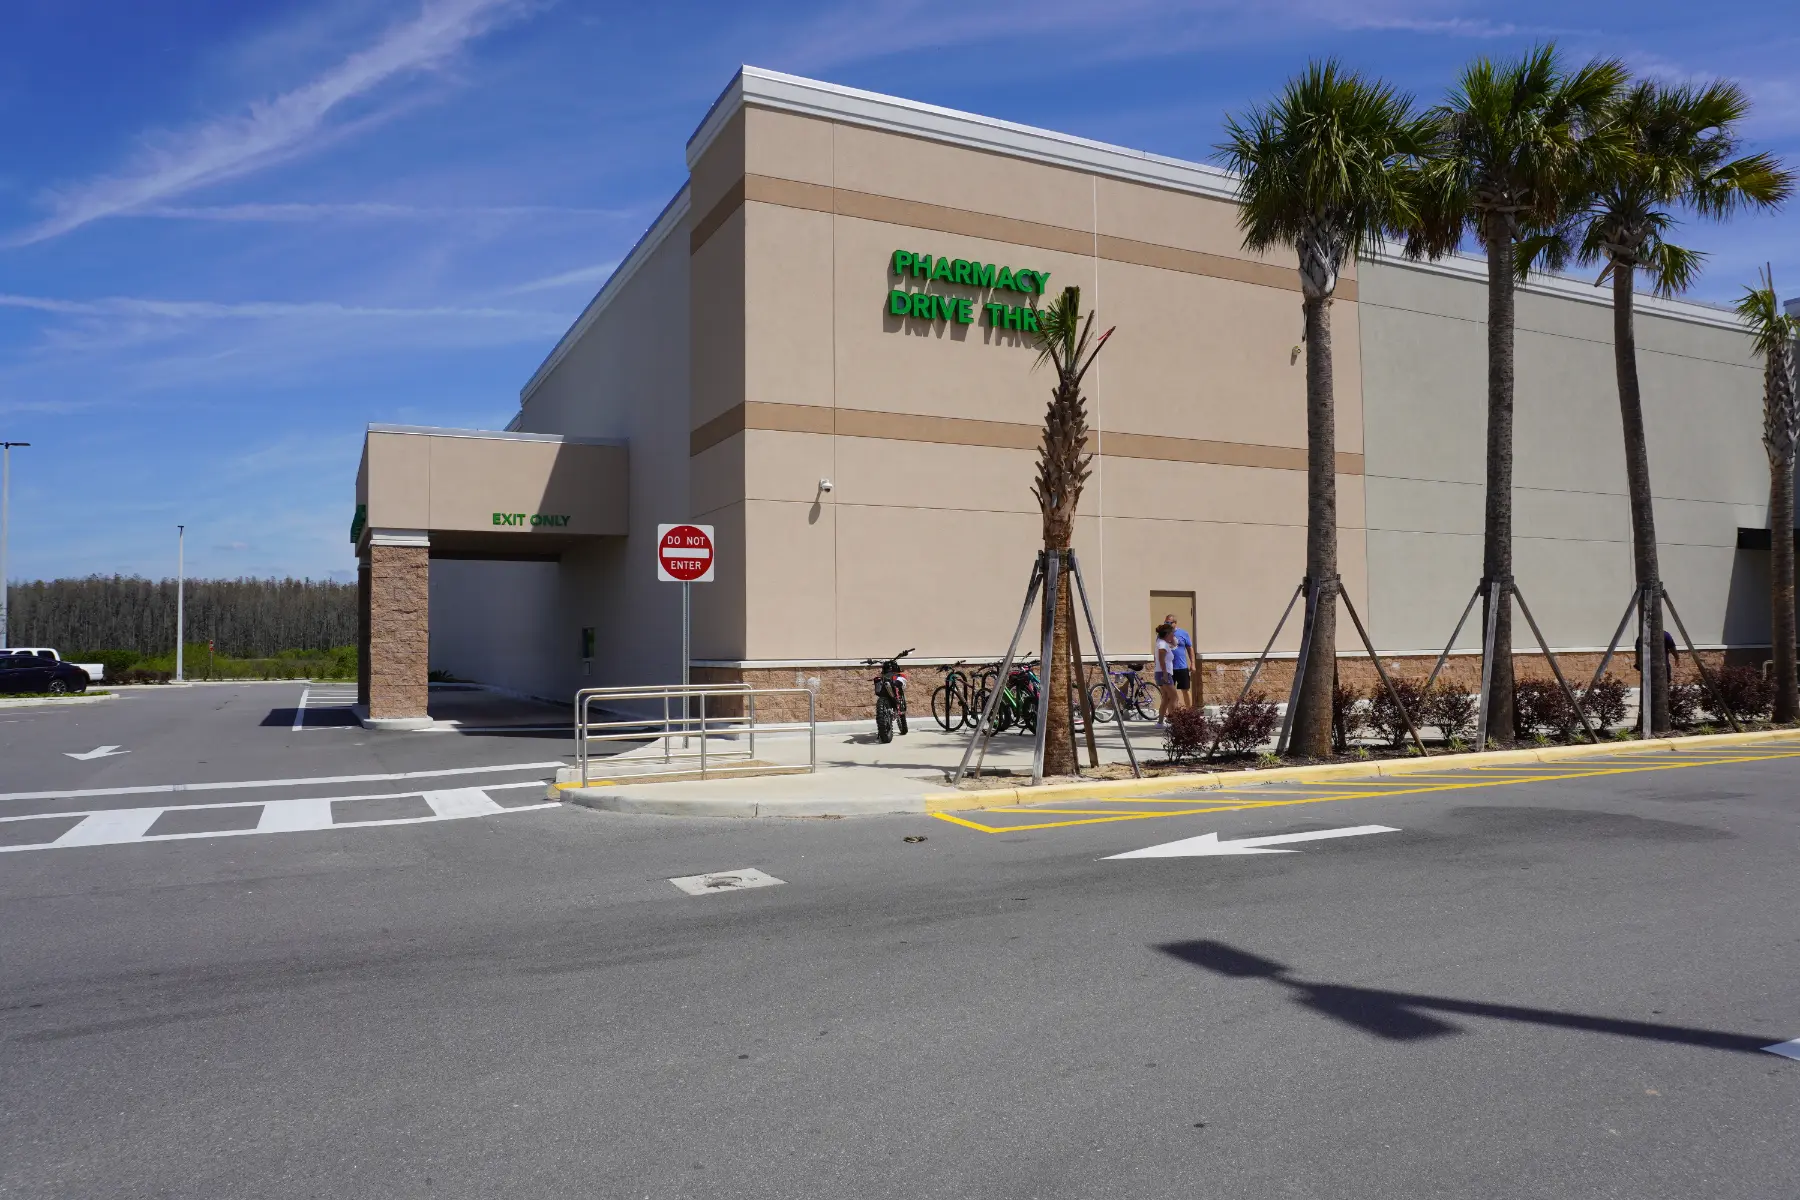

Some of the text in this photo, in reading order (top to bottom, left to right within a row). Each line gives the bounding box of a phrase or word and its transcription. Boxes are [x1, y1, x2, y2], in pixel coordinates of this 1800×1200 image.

[892, 250, 1051, 296] PHARMACY
[888, 289, 975, 324] DRIVE
[492, 513, 571, 527] EXIT ONLY
[667, 536, 705, 546] DO NOT
[670, 560, 702, 570] ENTER
